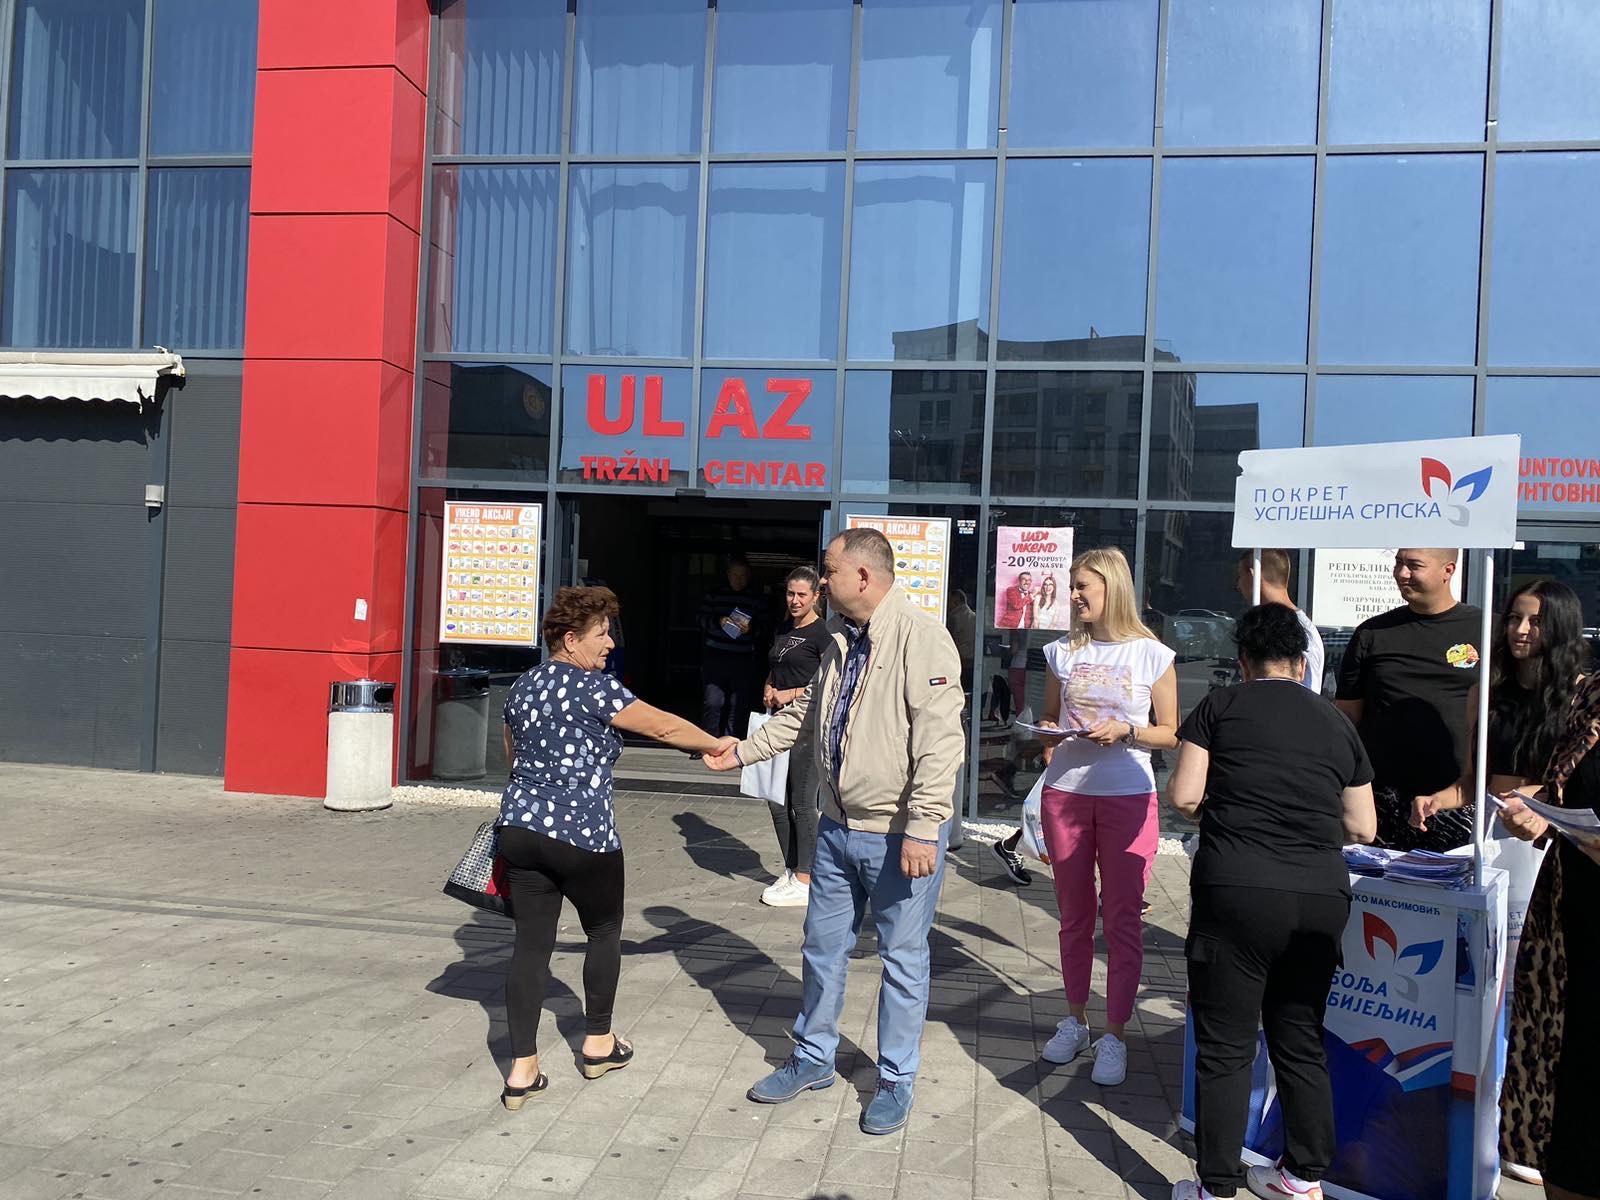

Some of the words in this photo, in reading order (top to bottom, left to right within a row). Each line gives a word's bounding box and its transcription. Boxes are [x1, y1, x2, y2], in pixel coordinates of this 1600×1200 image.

[580, 449, 670, 482] TRŽNI
[704, 459, 826, 487] CENTAR
[1254, 486, 1349, 503] ПОКРЕТ
[1255, 504, 1355, 521] УСПЈЕШНА
[1360, 502, 1442, 520] СРПСКА
[885, 522, 921, 536] AKCIJA!
[1002, 556, 1039, 567] -20%
[1328, 562, 1392, 572] РЕПУБЛИК
[1370, 896, 1441, 916] МАКСИМОВИЋ
[1327, 991, 1438, 1032] БИЈЕЉИНА
